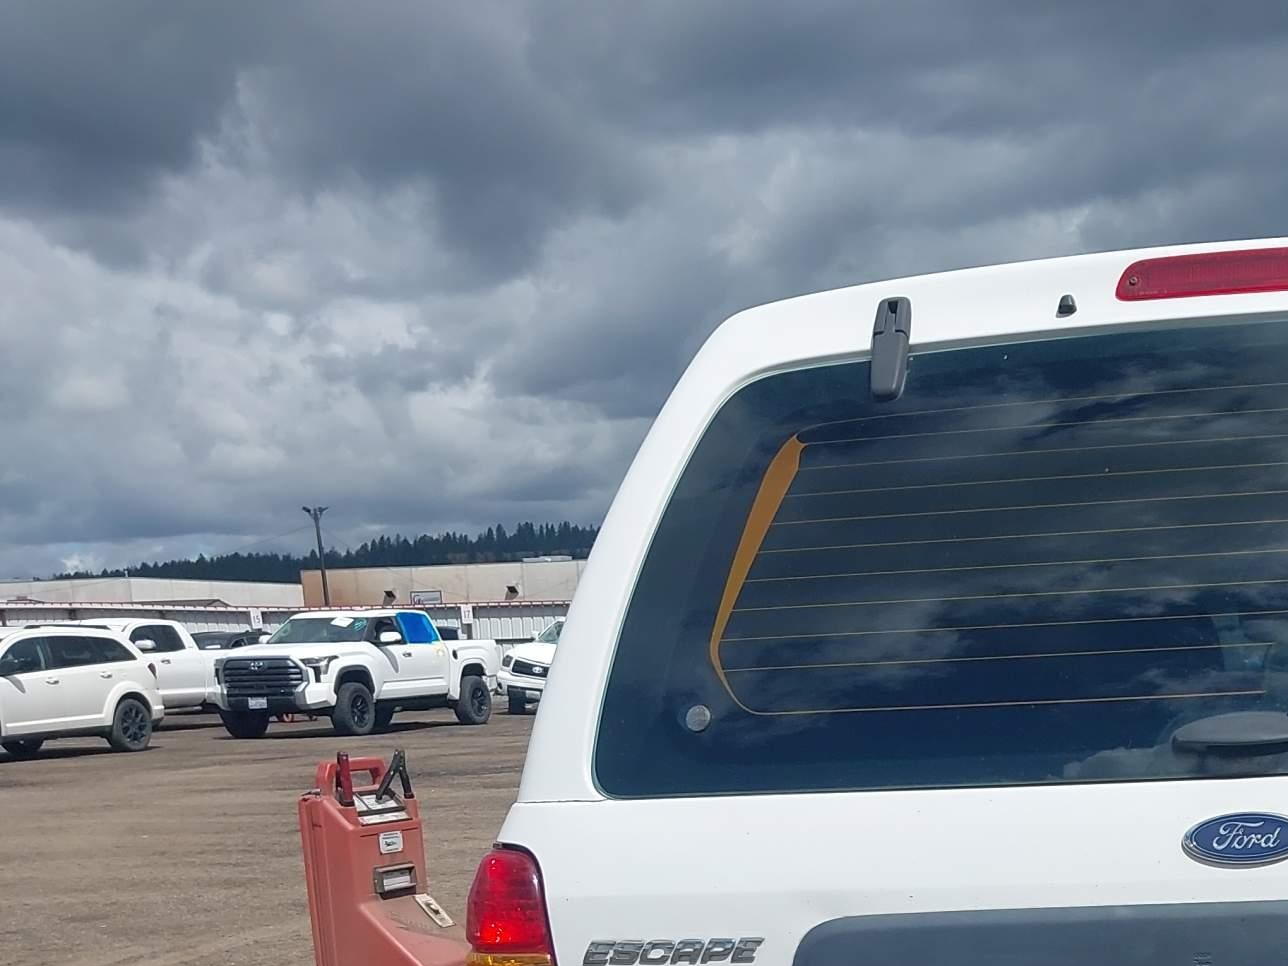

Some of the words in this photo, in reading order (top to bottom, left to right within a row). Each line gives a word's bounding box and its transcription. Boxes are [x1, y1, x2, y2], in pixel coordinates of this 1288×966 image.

[463, 610, 470, 619] 17
[1213, 821, 1281, 850] Ford
[582, 937, 765, 966] ESCAPE
